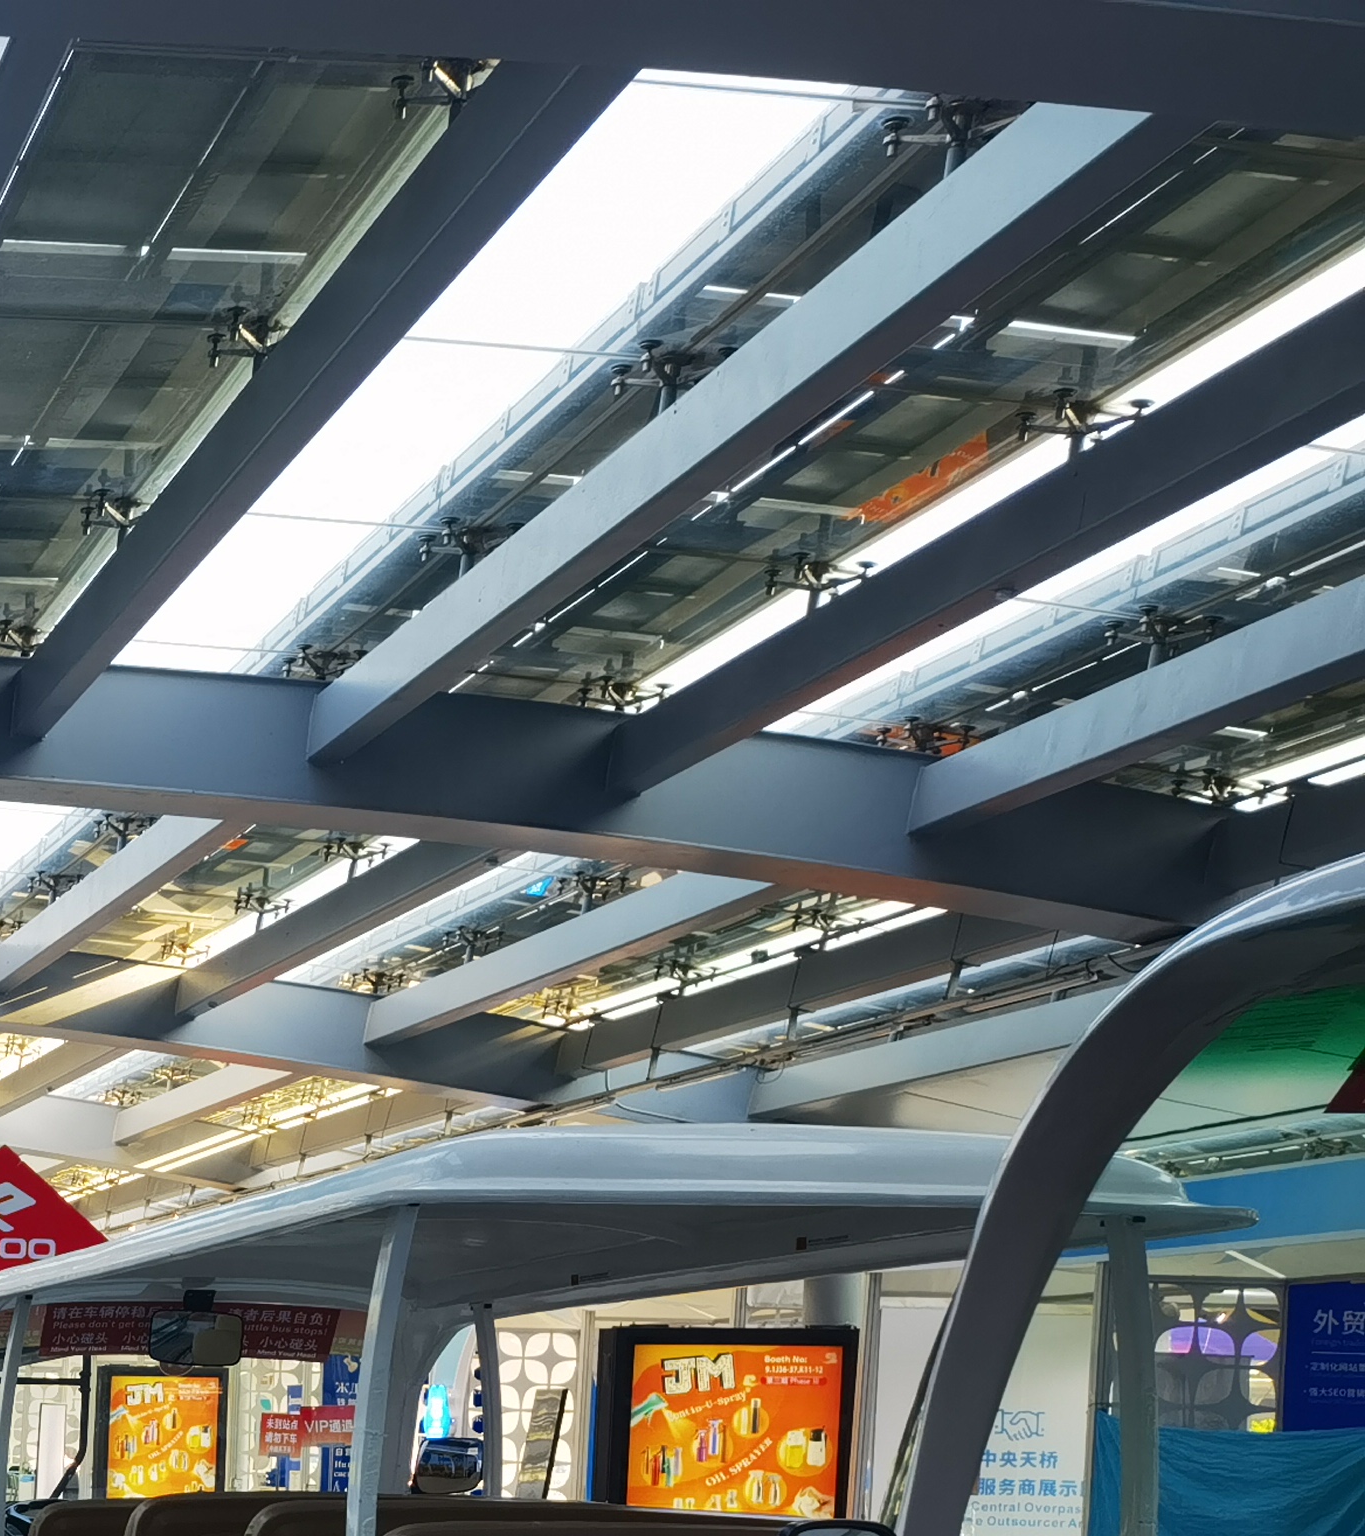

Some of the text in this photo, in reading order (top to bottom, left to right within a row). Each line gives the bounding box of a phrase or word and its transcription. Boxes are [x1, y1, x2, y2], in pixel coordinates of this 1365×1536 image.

[53, 1321, 86, 1329] Please
[118, 1321, 135, 1329] get
[243, 1324, 269, 1332] uttle
[294, 1327, 328, 1336] stops!
[52, 1332, 108, 1345] 小心碰头
[260, 1336, 318, 1351] 小心碰头
[764, 1354, 791, 1363] Booth
[661, 1353, 736, 1395] JM
[126, 1382, 165, 1406] JM
[266, 1418, 298, 1430] 未到站点
[265, 1432, 297, 1443] 请勿下车
[982, 1449, 1059, 1469] 中央天桥
[979, 1478, 1084, 1497] 服务商展示
[971, 1501, 1083, 1516] Central Overpas
[987, 1516, 1066, 1528] Outsourcer
